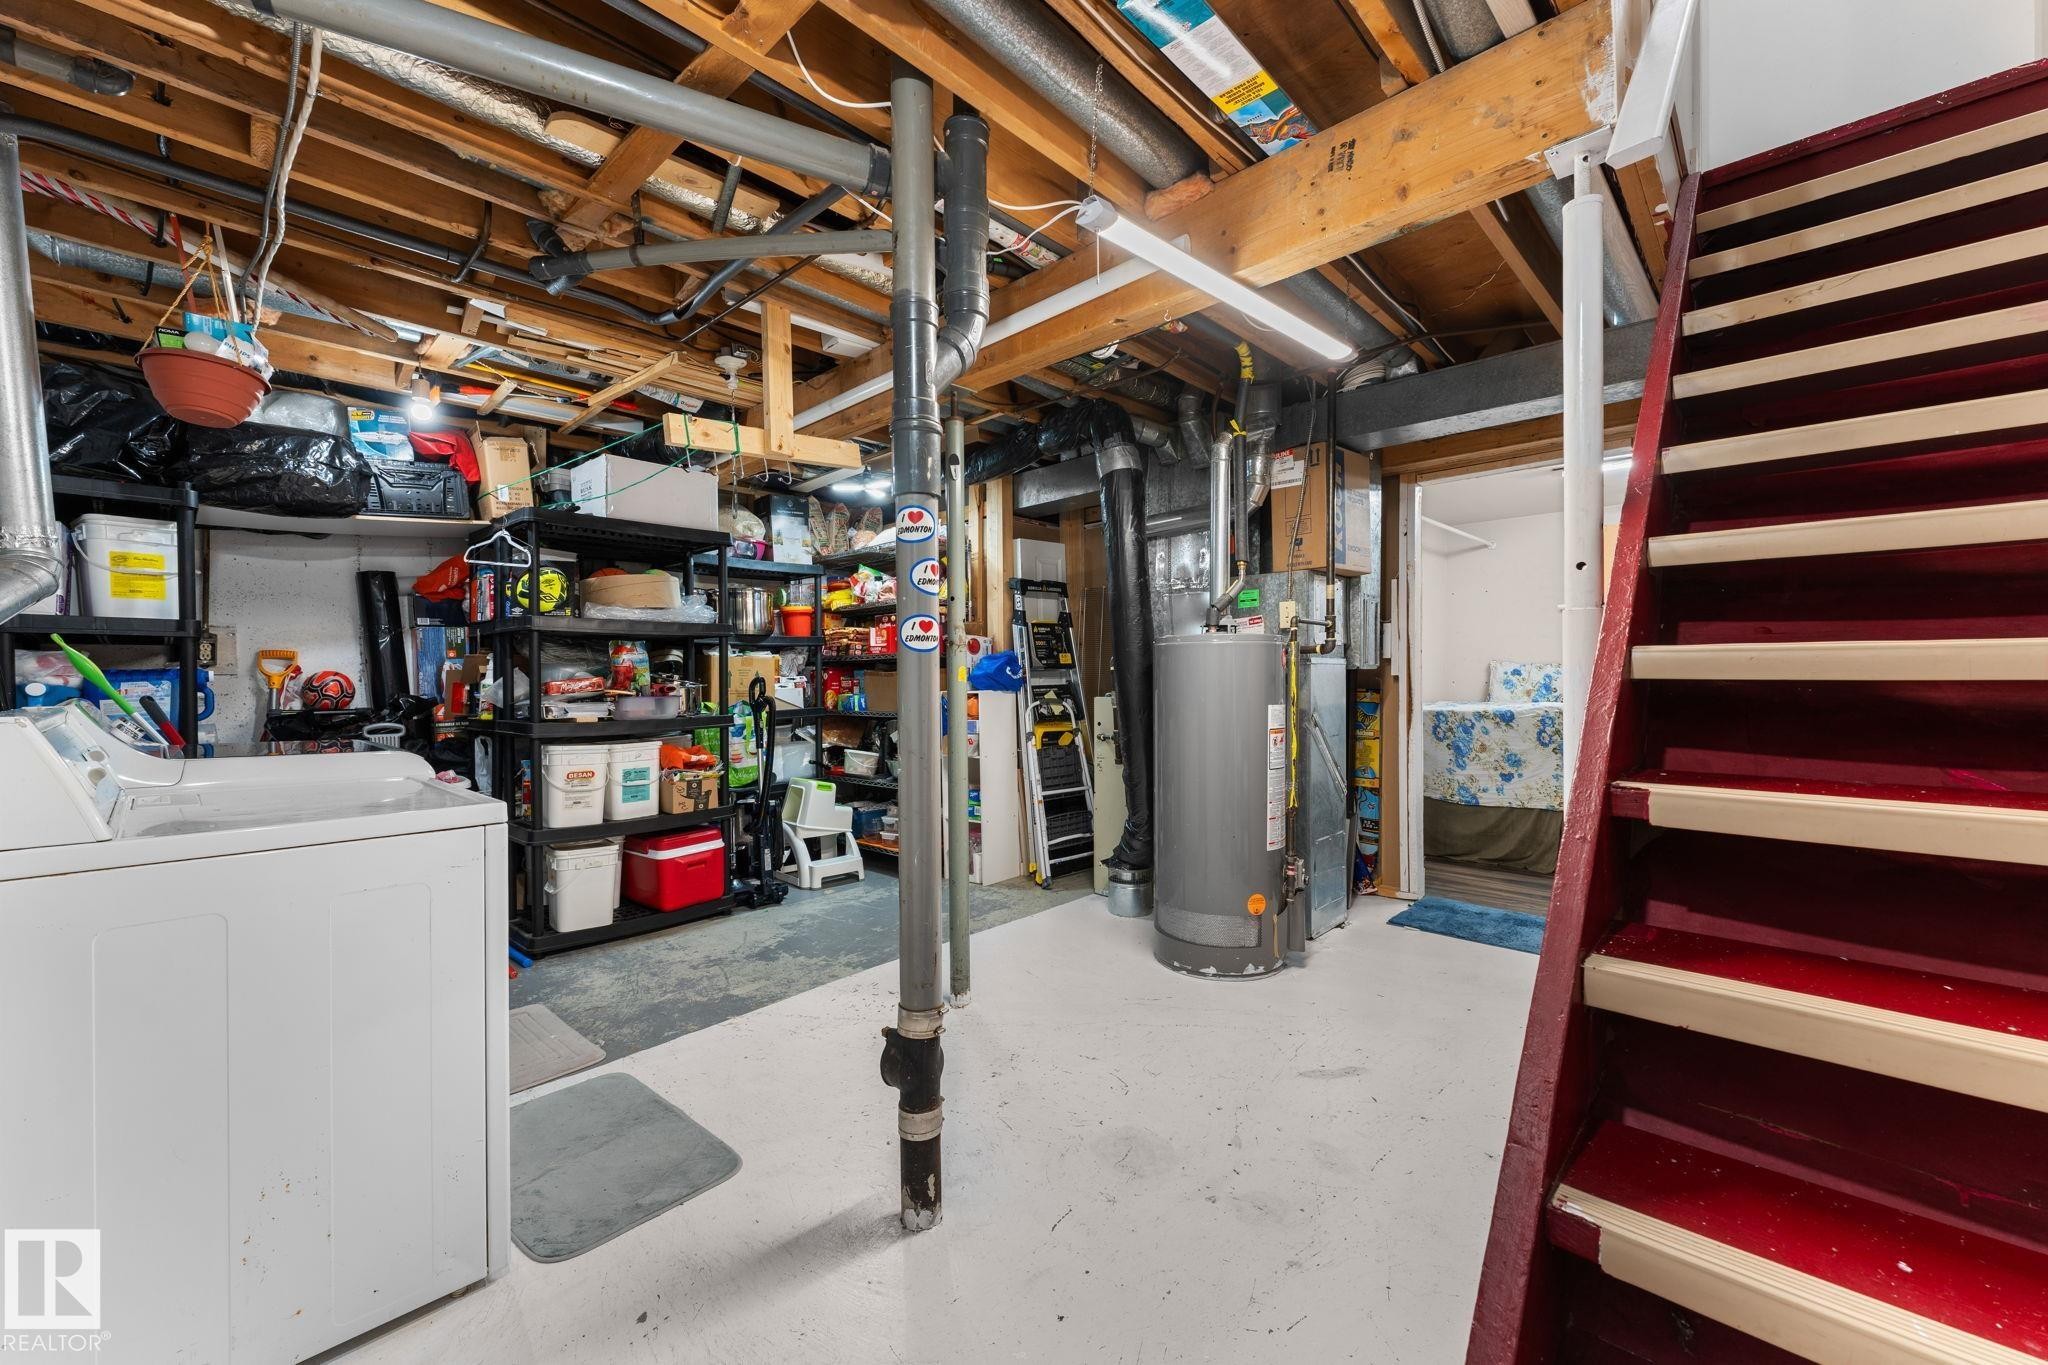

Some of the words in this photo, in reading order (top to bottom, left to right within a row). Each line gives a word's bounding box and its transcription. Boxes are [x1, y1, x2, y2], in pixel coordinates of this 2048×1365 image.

[224, 341, 251, 359] PHIIPS
[897, 525, 932, 535] EDMONTON
[917, 577, 938, 586] EDMO
[904, 634, 939, 642] EDMONTO
